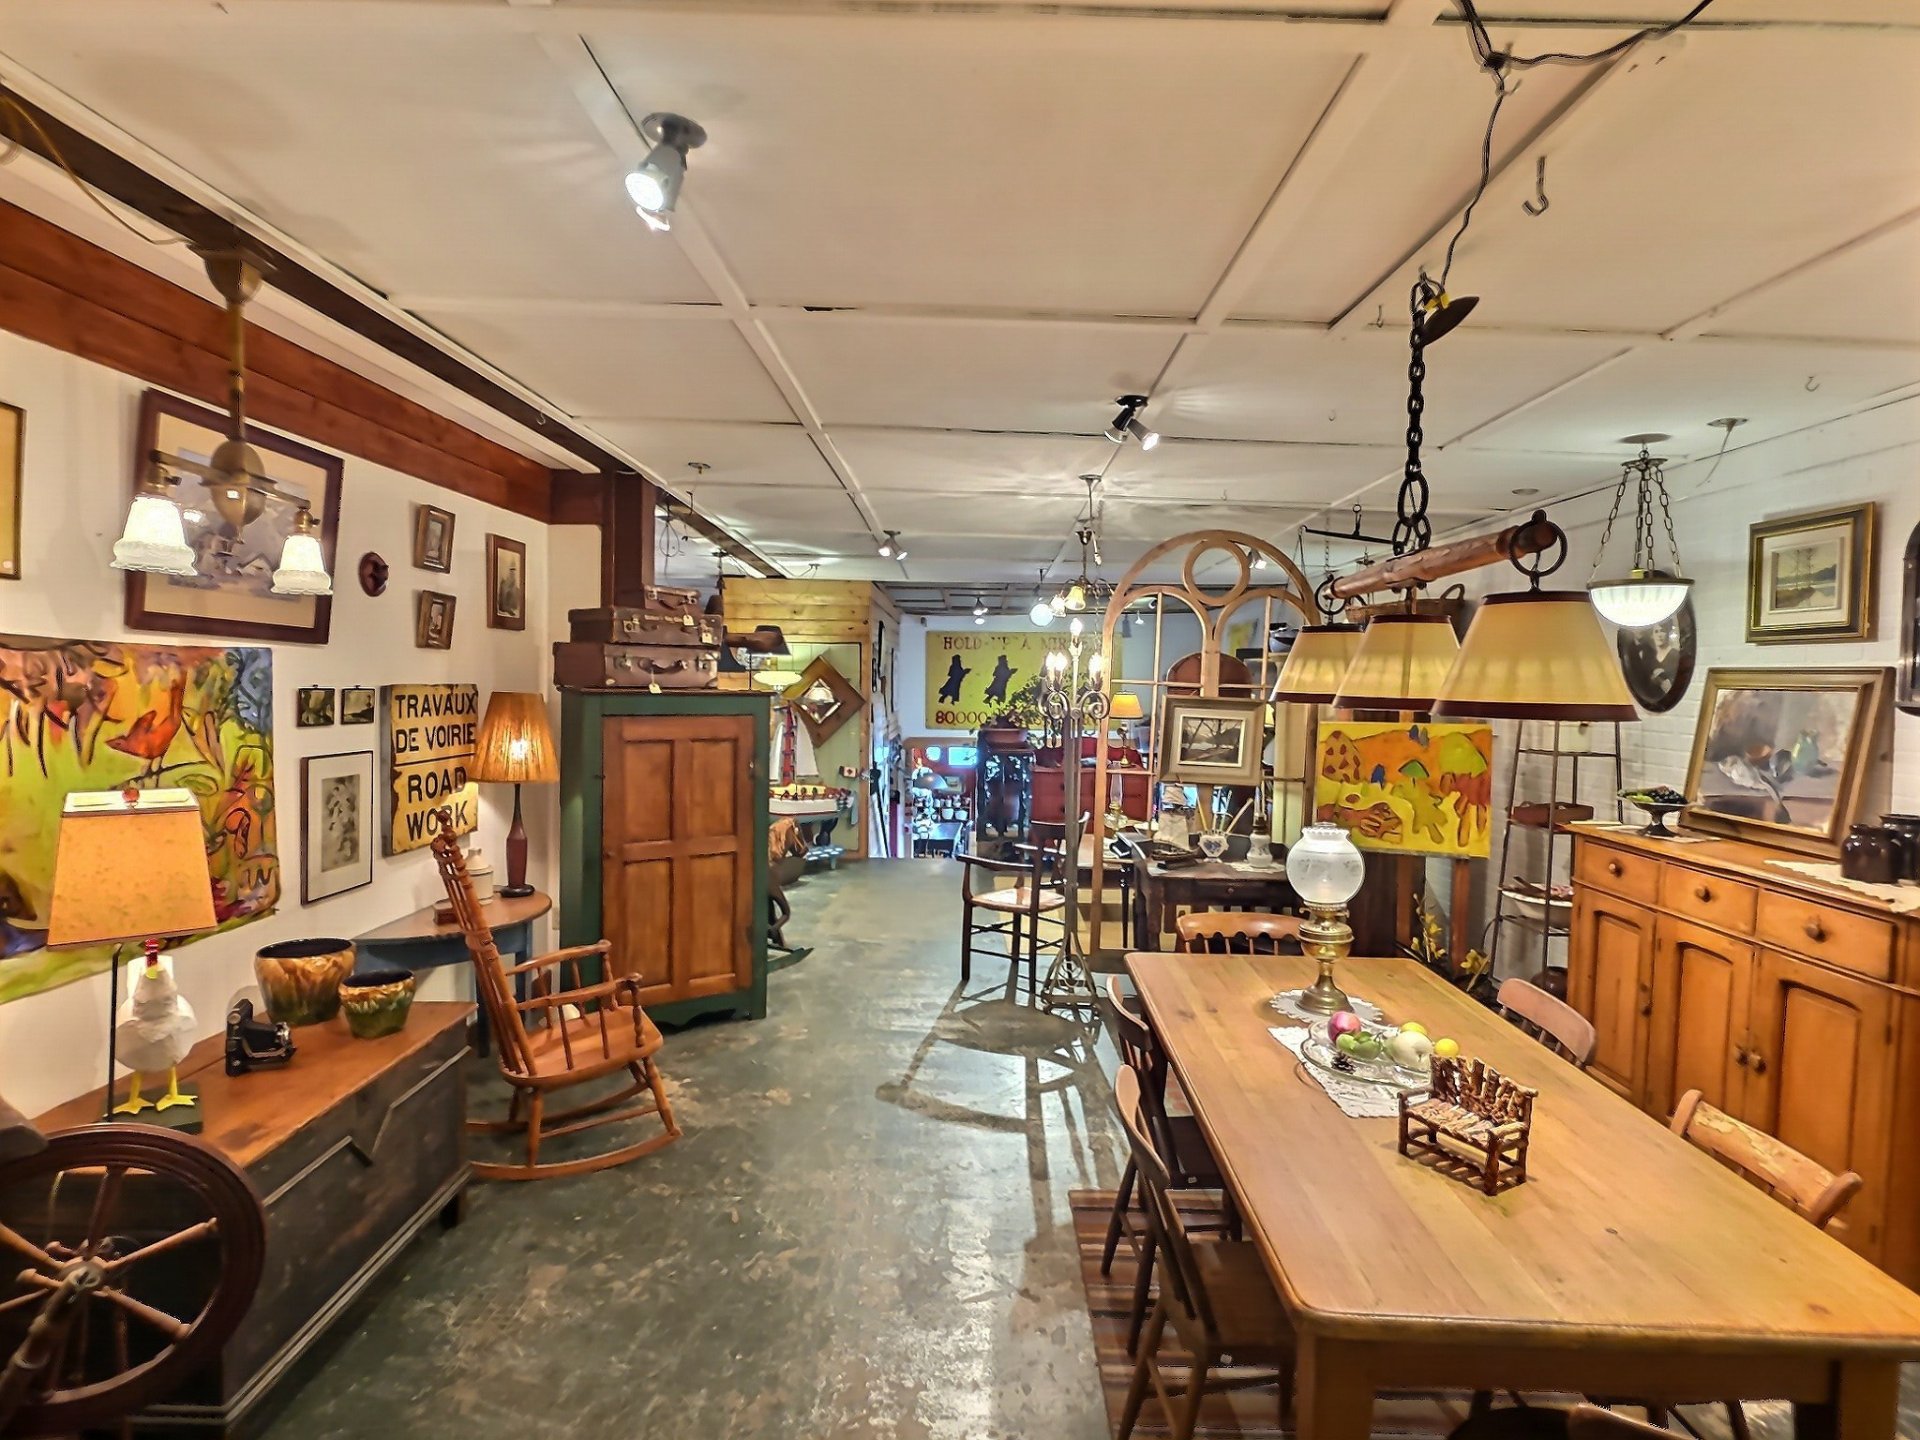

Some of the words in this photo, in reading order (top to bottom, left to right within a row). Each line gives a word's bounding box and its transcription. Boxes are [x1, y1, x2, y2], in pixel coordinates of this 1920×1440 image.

[395, 692, 477, 719] TRAVAUX
[395, 728, 419, 754] DE
[425, 722, 477, 750] VOIRIE
[407, 766, 467, 803] ROAD
